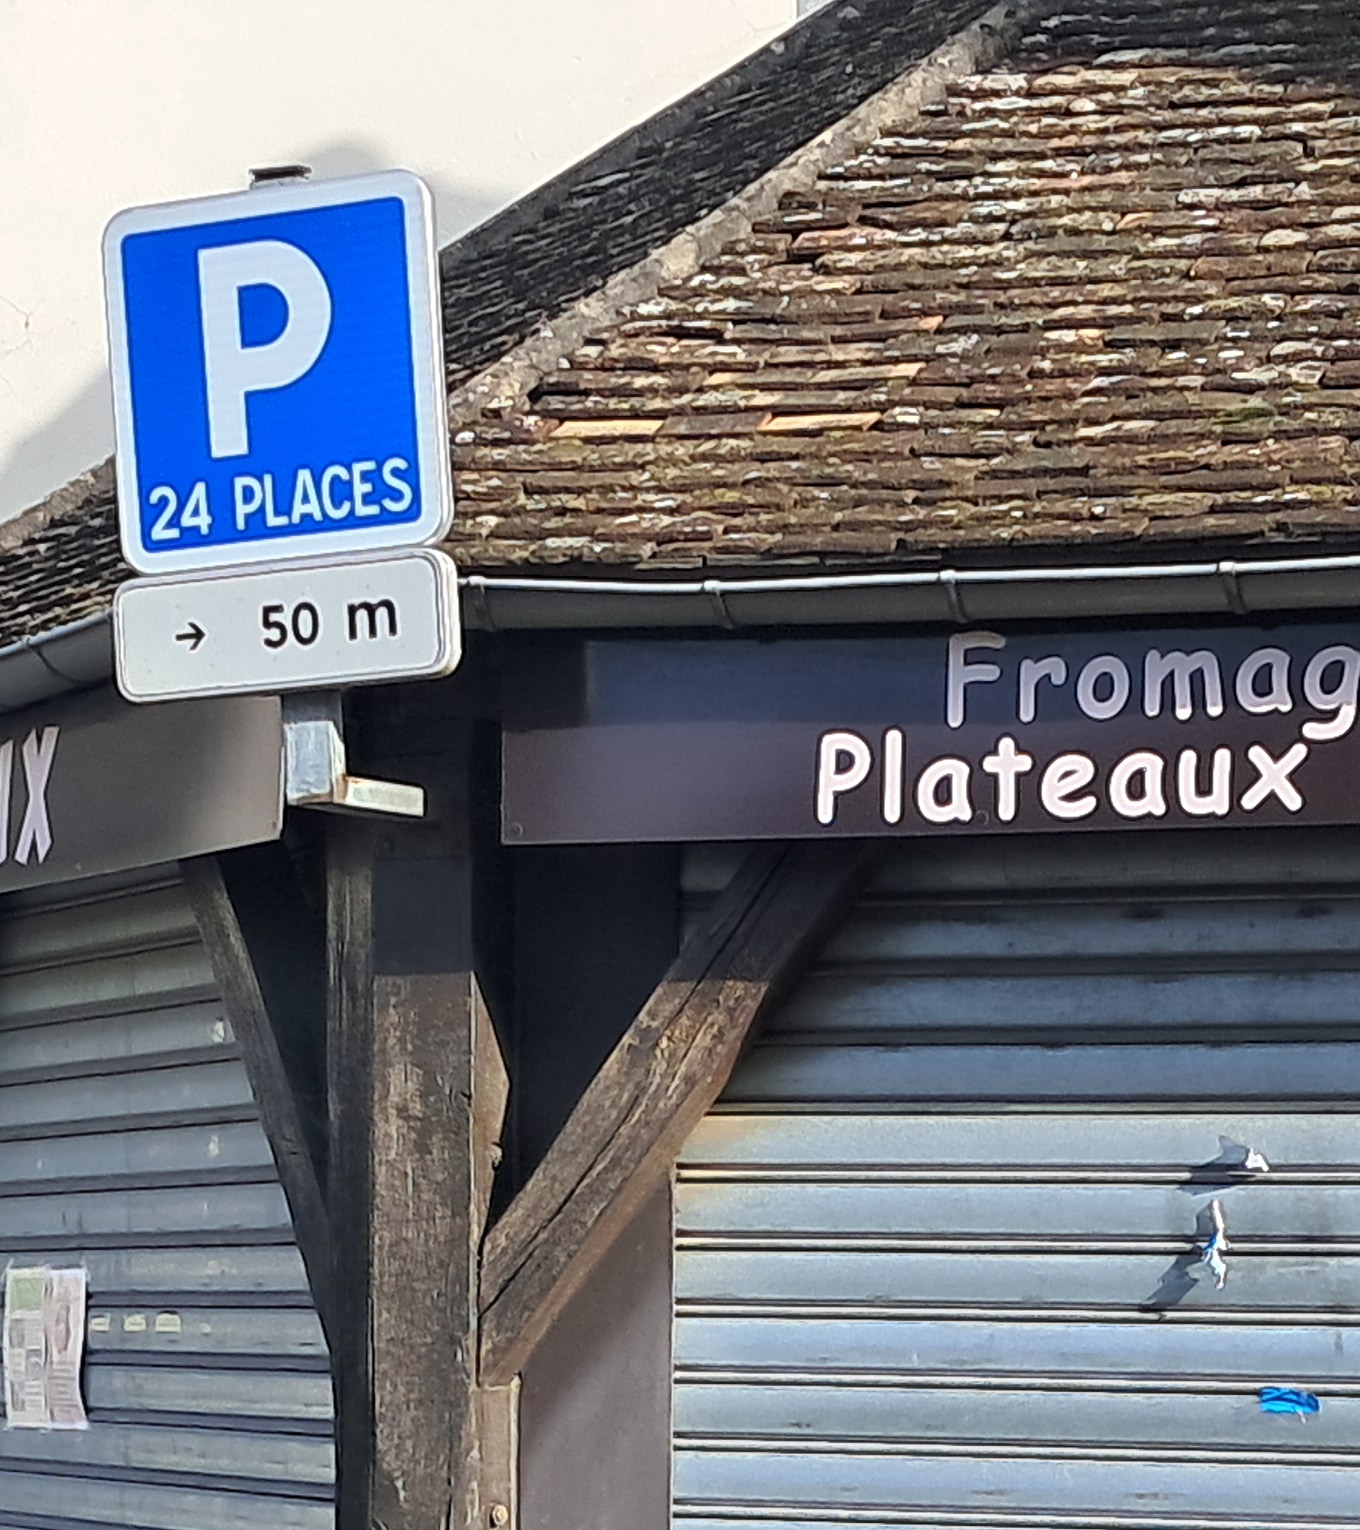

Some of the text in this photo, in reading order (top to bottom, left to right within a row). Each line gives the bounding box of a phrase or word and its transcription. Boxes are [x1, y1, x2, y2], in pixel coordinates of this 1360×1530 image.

[196, 238, 332, 459] P
[148, 456, 414, 542] 24 PLACES
[260, 596, 398, 649] 50 m
[813, 728, 1310, 826] Plateaux
